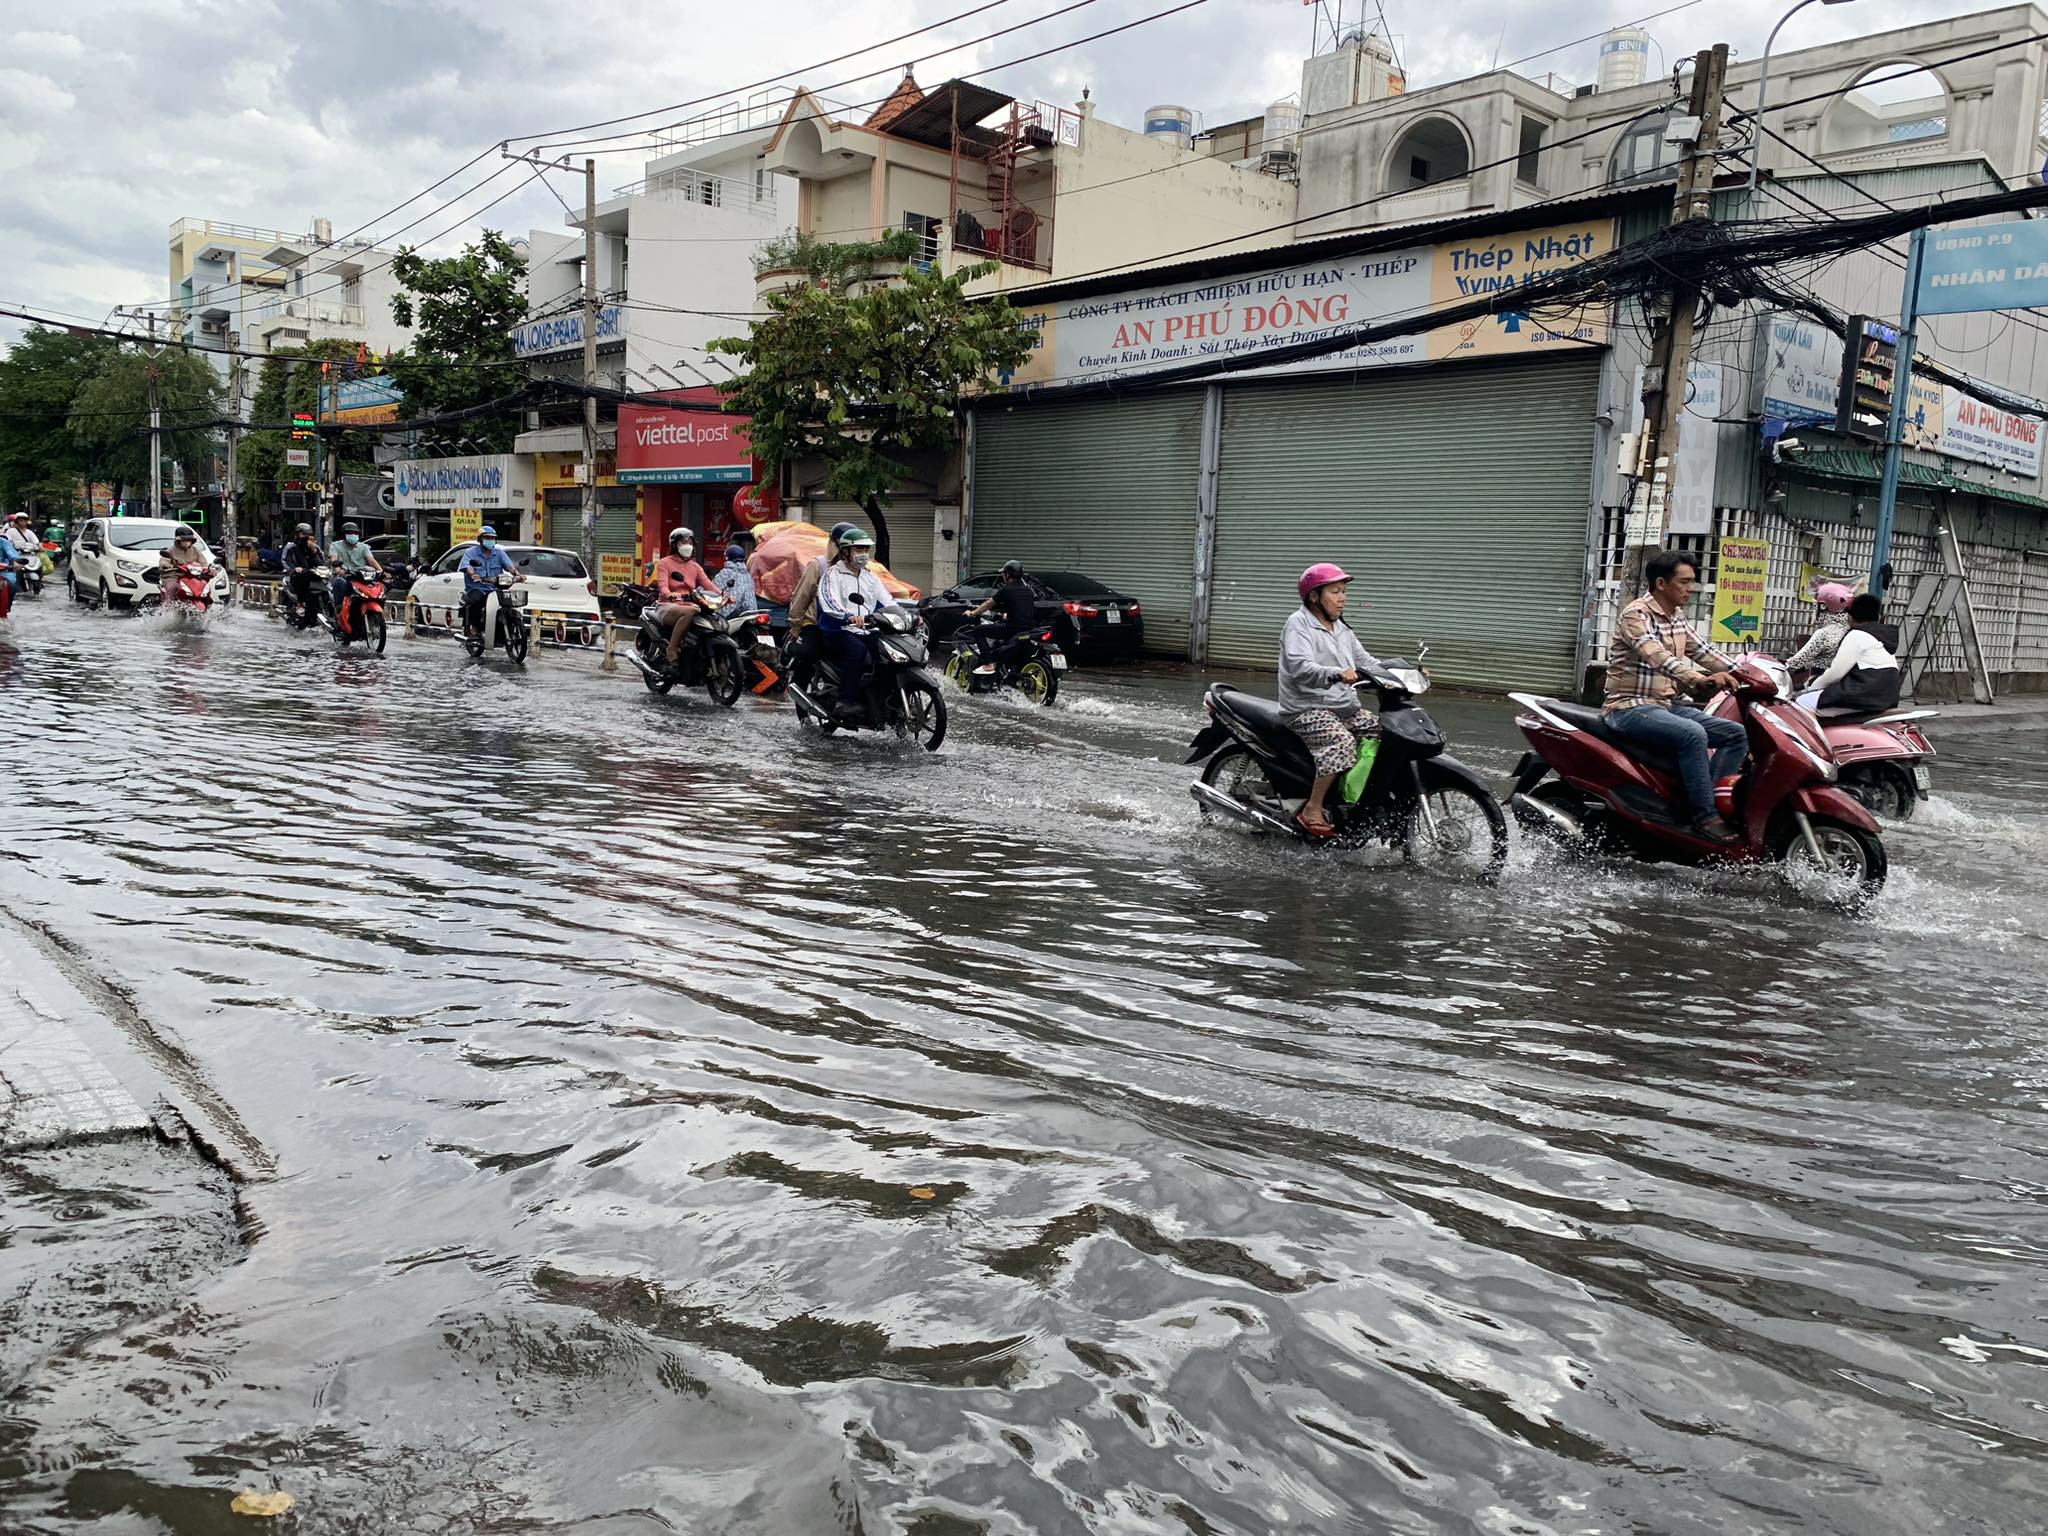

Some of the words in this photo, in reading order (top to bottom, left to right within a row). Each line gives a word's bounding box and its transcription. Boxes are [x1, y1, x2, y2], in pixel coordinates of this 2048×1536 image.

[1450, 242, 1513, 271] Thép
[1525, 232, 1594, 262] Nhật
[1935, 236, 1983, 251] UBND
[1988, 233, 2013, 246] P.9
[1069, 303, 1108, 320] CÔNG
[1113, 300, 1135, 314] TY
[1136, 291, 1188, 311] TRÁCH
[1194, 282, 1250, 303] NHIỆM
[1257, 270, 1297, 293] HỮU
[1302, 268, 1344, 288] HẠN
[1361, 256, 1418, 279] THÉP
[1931, 268, 2007, 288] NHÂN
[1112, 319, 1155, 348] AN
[1163, 302, 1232, 342] PHÚ
[1242, 294, 1348, 332] ĐÔNG
[1531, 332, 1544, 343] ISO
[1573, 328, 1594, 340] 2015
[1079, 352, 1117, 368] Chuyên
[1151, 344, 1193, 360] Doanh:
[1199, 338, 1219, 354] Sắt
[1224, 338, 1257, 352] Thép
[1261, 334, 1286, 348] Xây
[1379, 345, 1398, 356] 5895
[1400, 343, 1415, 354] 697
[1957, 400, 1977, 426] AN
[635, 423, 695, 447] viettel
[697, 424, 729, 447] post
